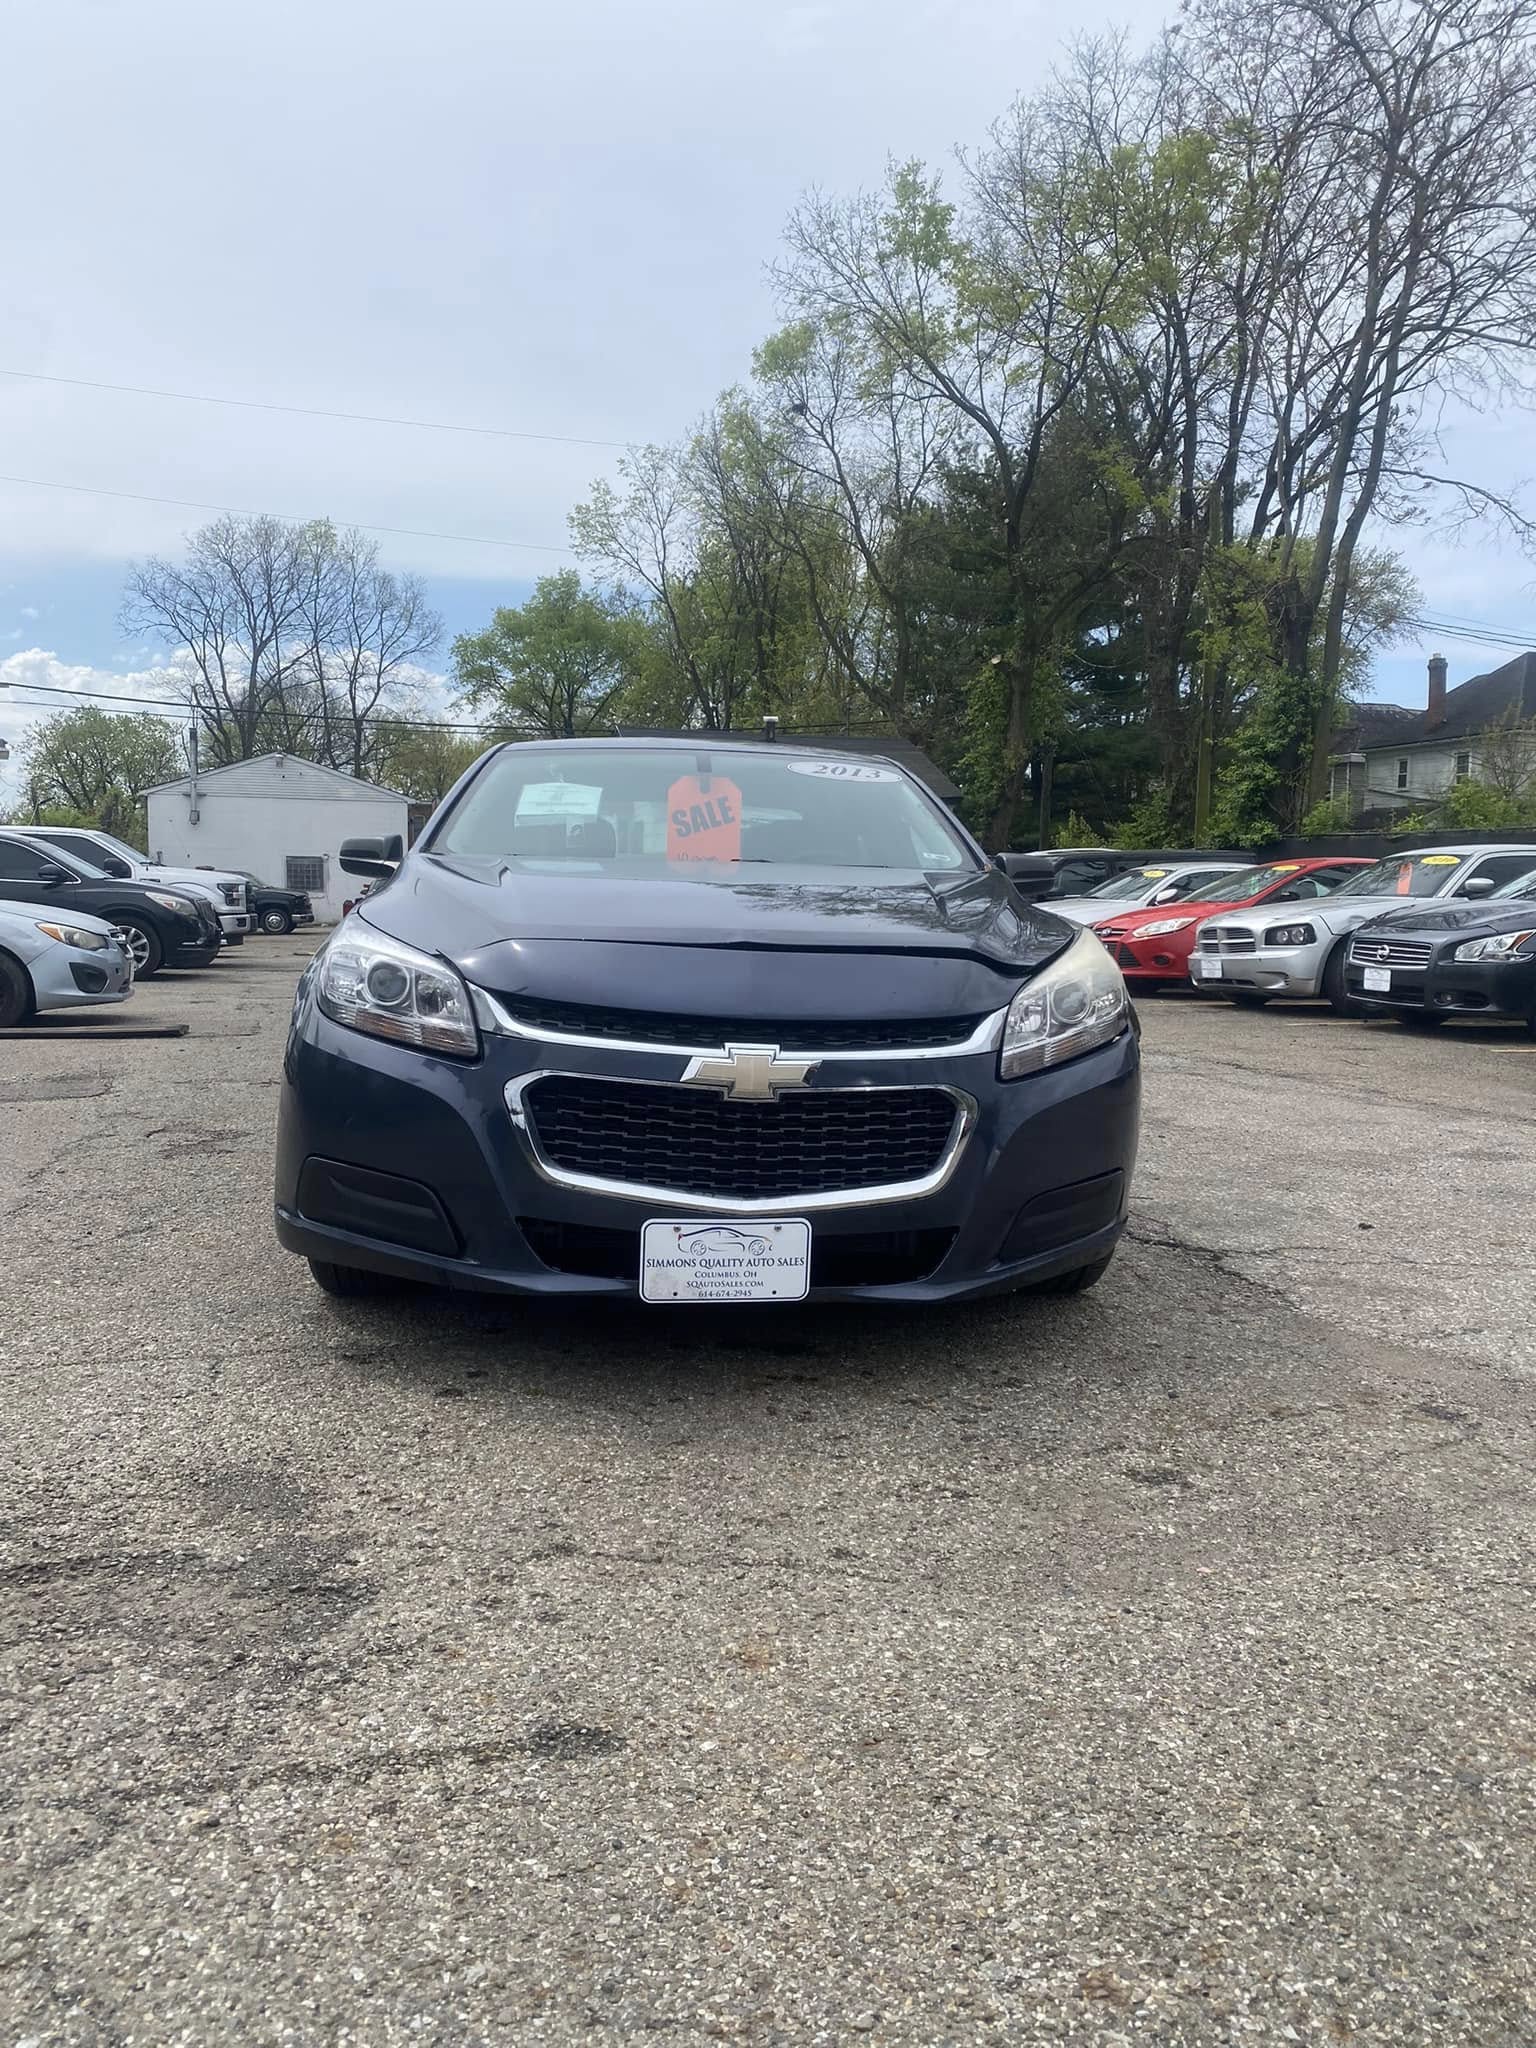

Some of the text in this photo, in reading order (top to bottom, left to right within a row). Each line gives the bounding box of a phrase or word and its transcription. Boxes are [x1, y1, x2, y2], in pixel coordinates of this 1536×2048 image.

[812, 764, 881, 779] 2013
[672, 796, 735, 837] SALE
[646, 1257, 805, 1269] SIMMONS QUALITY AUTO SALES
